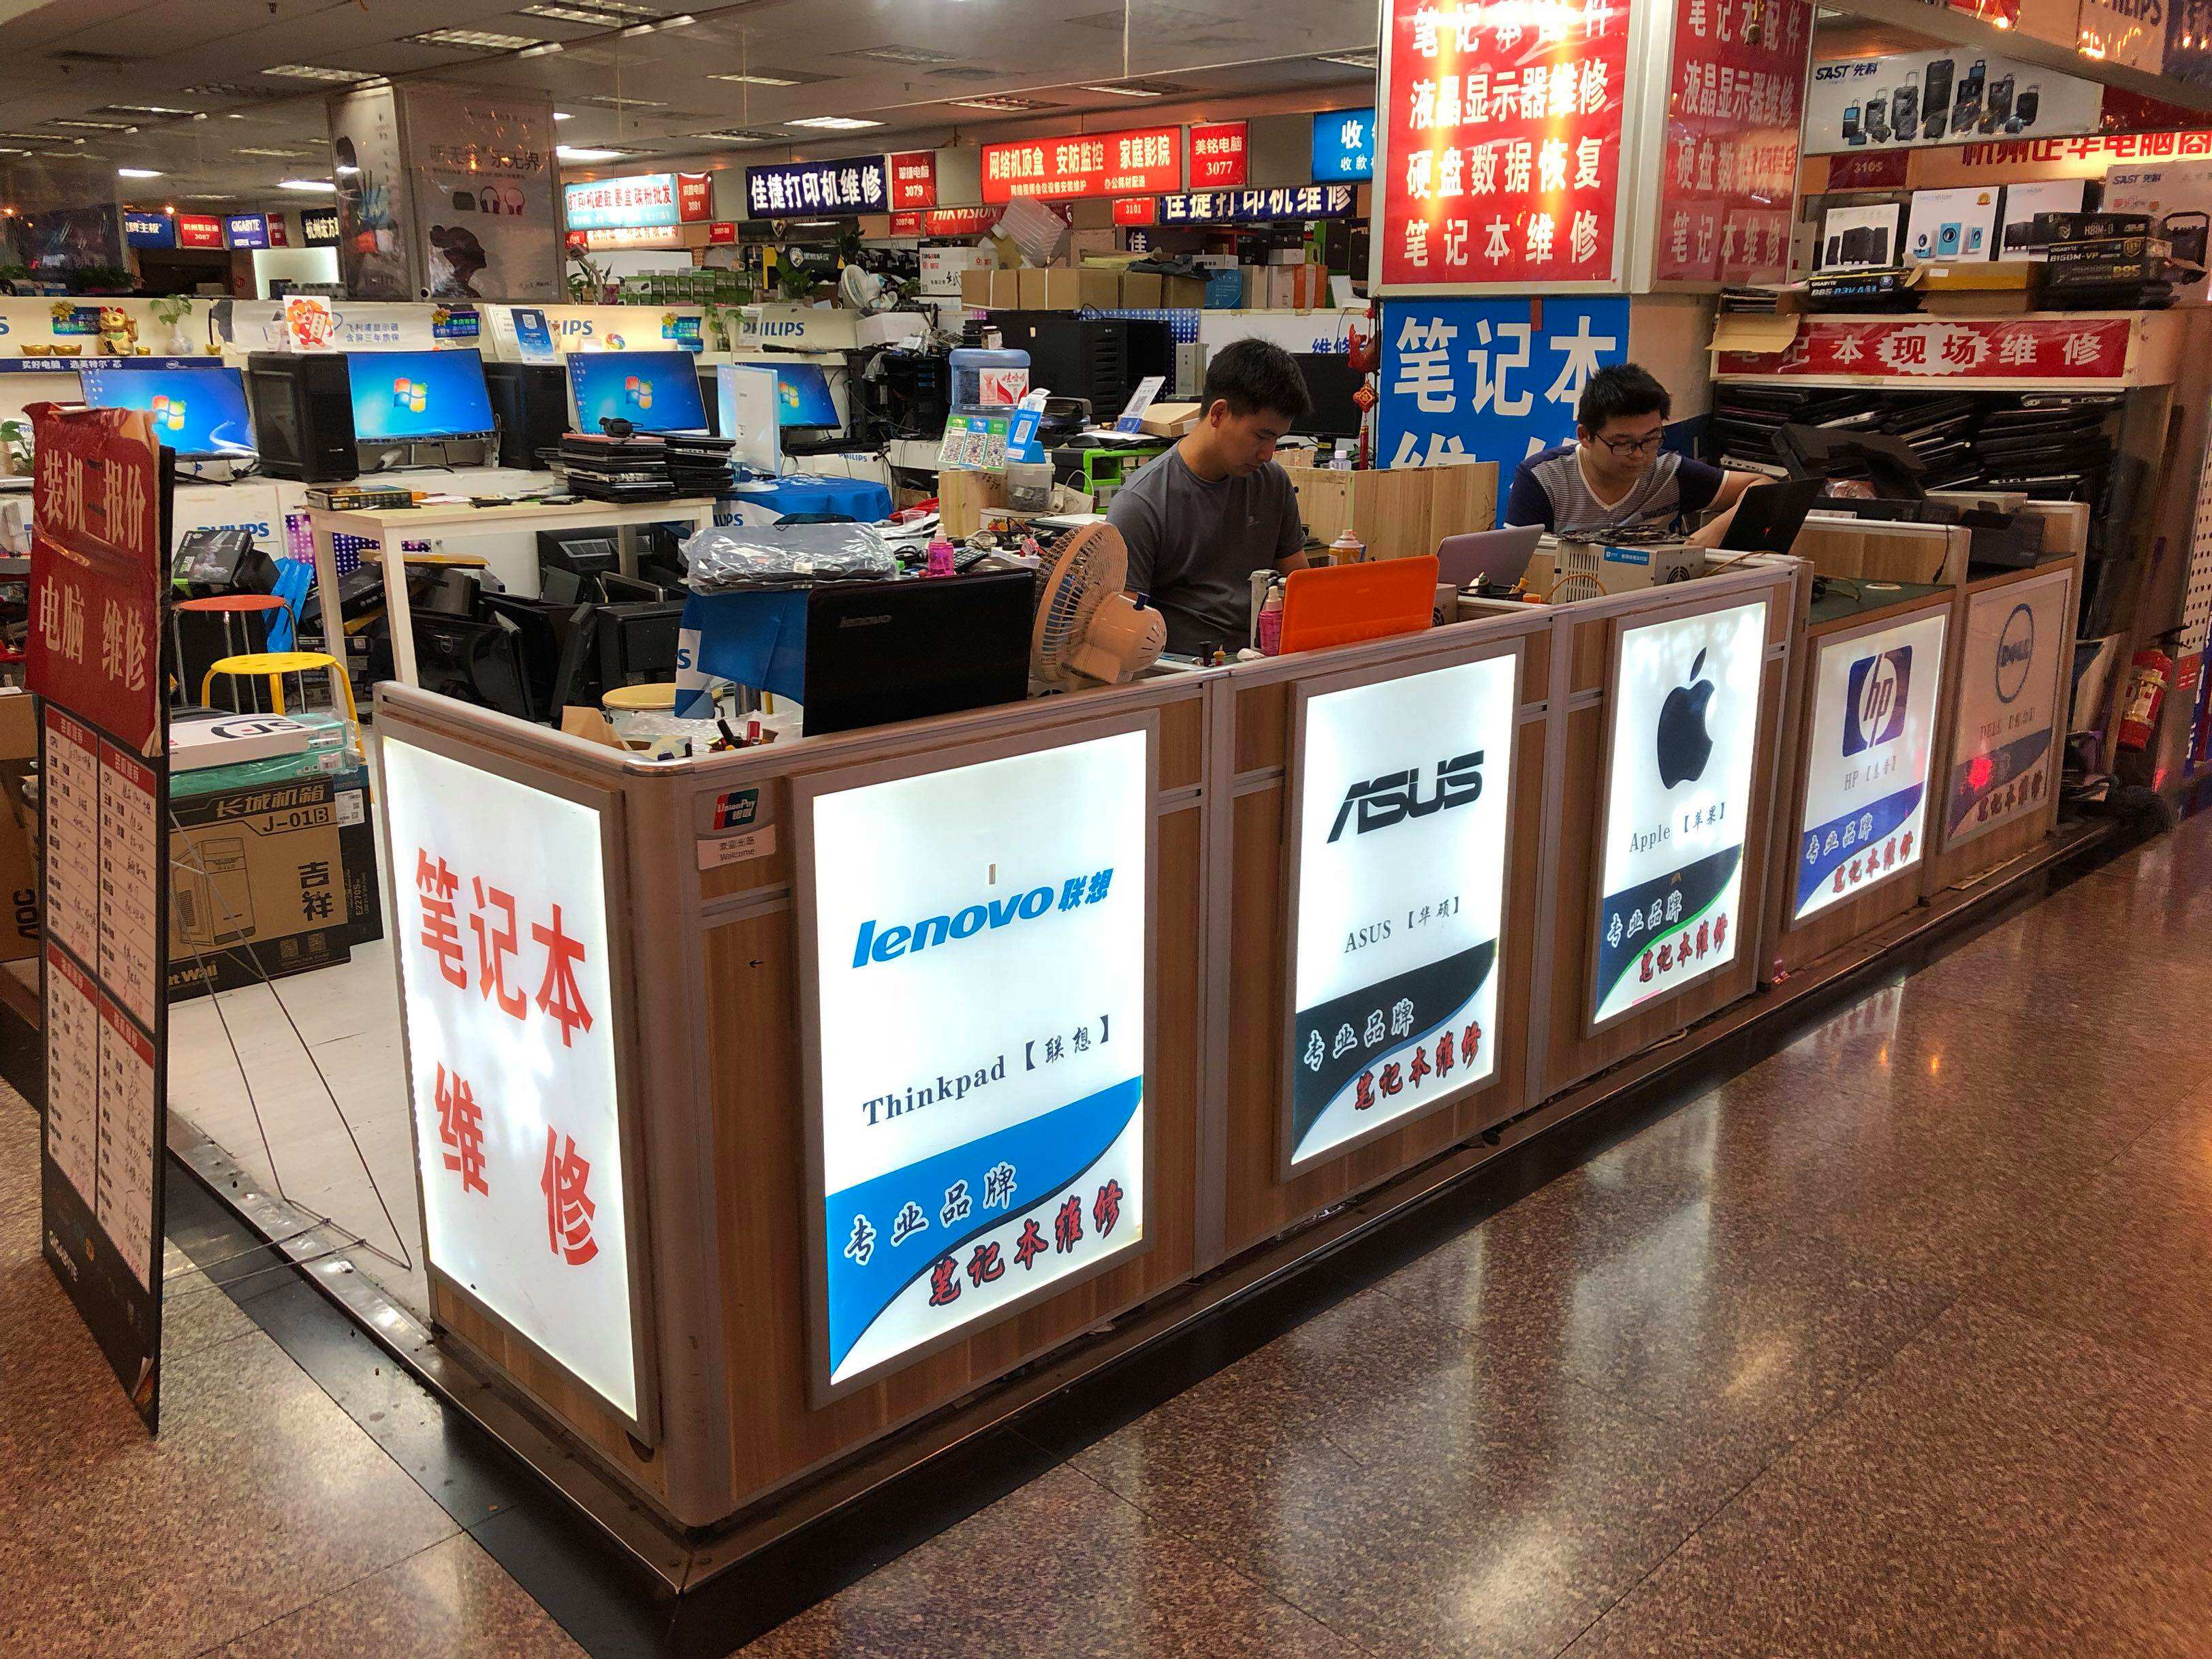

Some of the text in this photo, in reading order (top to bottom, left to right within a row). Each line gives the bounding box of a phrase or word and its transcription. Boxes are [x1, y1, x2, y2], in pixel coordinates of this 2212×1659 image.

[1409, 58, 1608, 129] 液晶显示器维修
[1681, 59, 1795, 130] 液晶显示器维修
[1816, 65, 1850, 80] SAST
[990, 134, 1171, 180] 网络机顶盒 安防监控 家庭影院
[1195, 136, 1242, 156] 美铭电脑
[1340, 155, 1374, 171] 收款
[1341, 120, 1375, 148] 收
[751, 165, 883, 211] 佳捷打印机维修
[904, 185, 923, 198] 3079
[1205, 161, 1233, 177] 3077
[1406, 136, 1602, 200] 硬盘数据恢复
[231, 219, 261, 232] GIGABYTE
[1125, 204, 1142, 215] 3101
[1671, 211, 1781, 266] 笔记本维修
[1404, 210, 1599, 268] 笔记本维修
[345, 322, 400, 332] 飞利浦显示器
[1394, 316, 1617, 422] 笔记本
[43, 449, 146, 552] 装机 报价
[39, 575, 146, 692] 电脑 维修
[217, 785, 325, 818] 长城机箱
[716, 798, 757, 813] UnionPay
[1326, 750, 1485, 844] ASUS
[1844, 772, 1859, 791] HP
[1629, 823, 1671, 853] Apple
[1806, 812, 1873, 865] 专业品牌
[298, 861, 334, 921] 吉祥
[852, 868, 1115, 969] lenovo 联想
[1607, 889, 1683, 948] 专业品牌
[415, 847, 594, 1049] 笔记本
[1344, 919, 1391, 953] ASUS
[1639, 912, 1728, 983] 笔记本维修
[1304, 998, 1415, 1073] 专业品牌
[862, 1055, 1007, 1127] Thinkpad
[1355, 1020, 1483, 1111] 笔记本维修
[434, 1060, 601, 1267] 维修
[844, 1160, 1017, 1267] 专业品牌
[928, 1178, 1124, 1308] 笔记本维修
